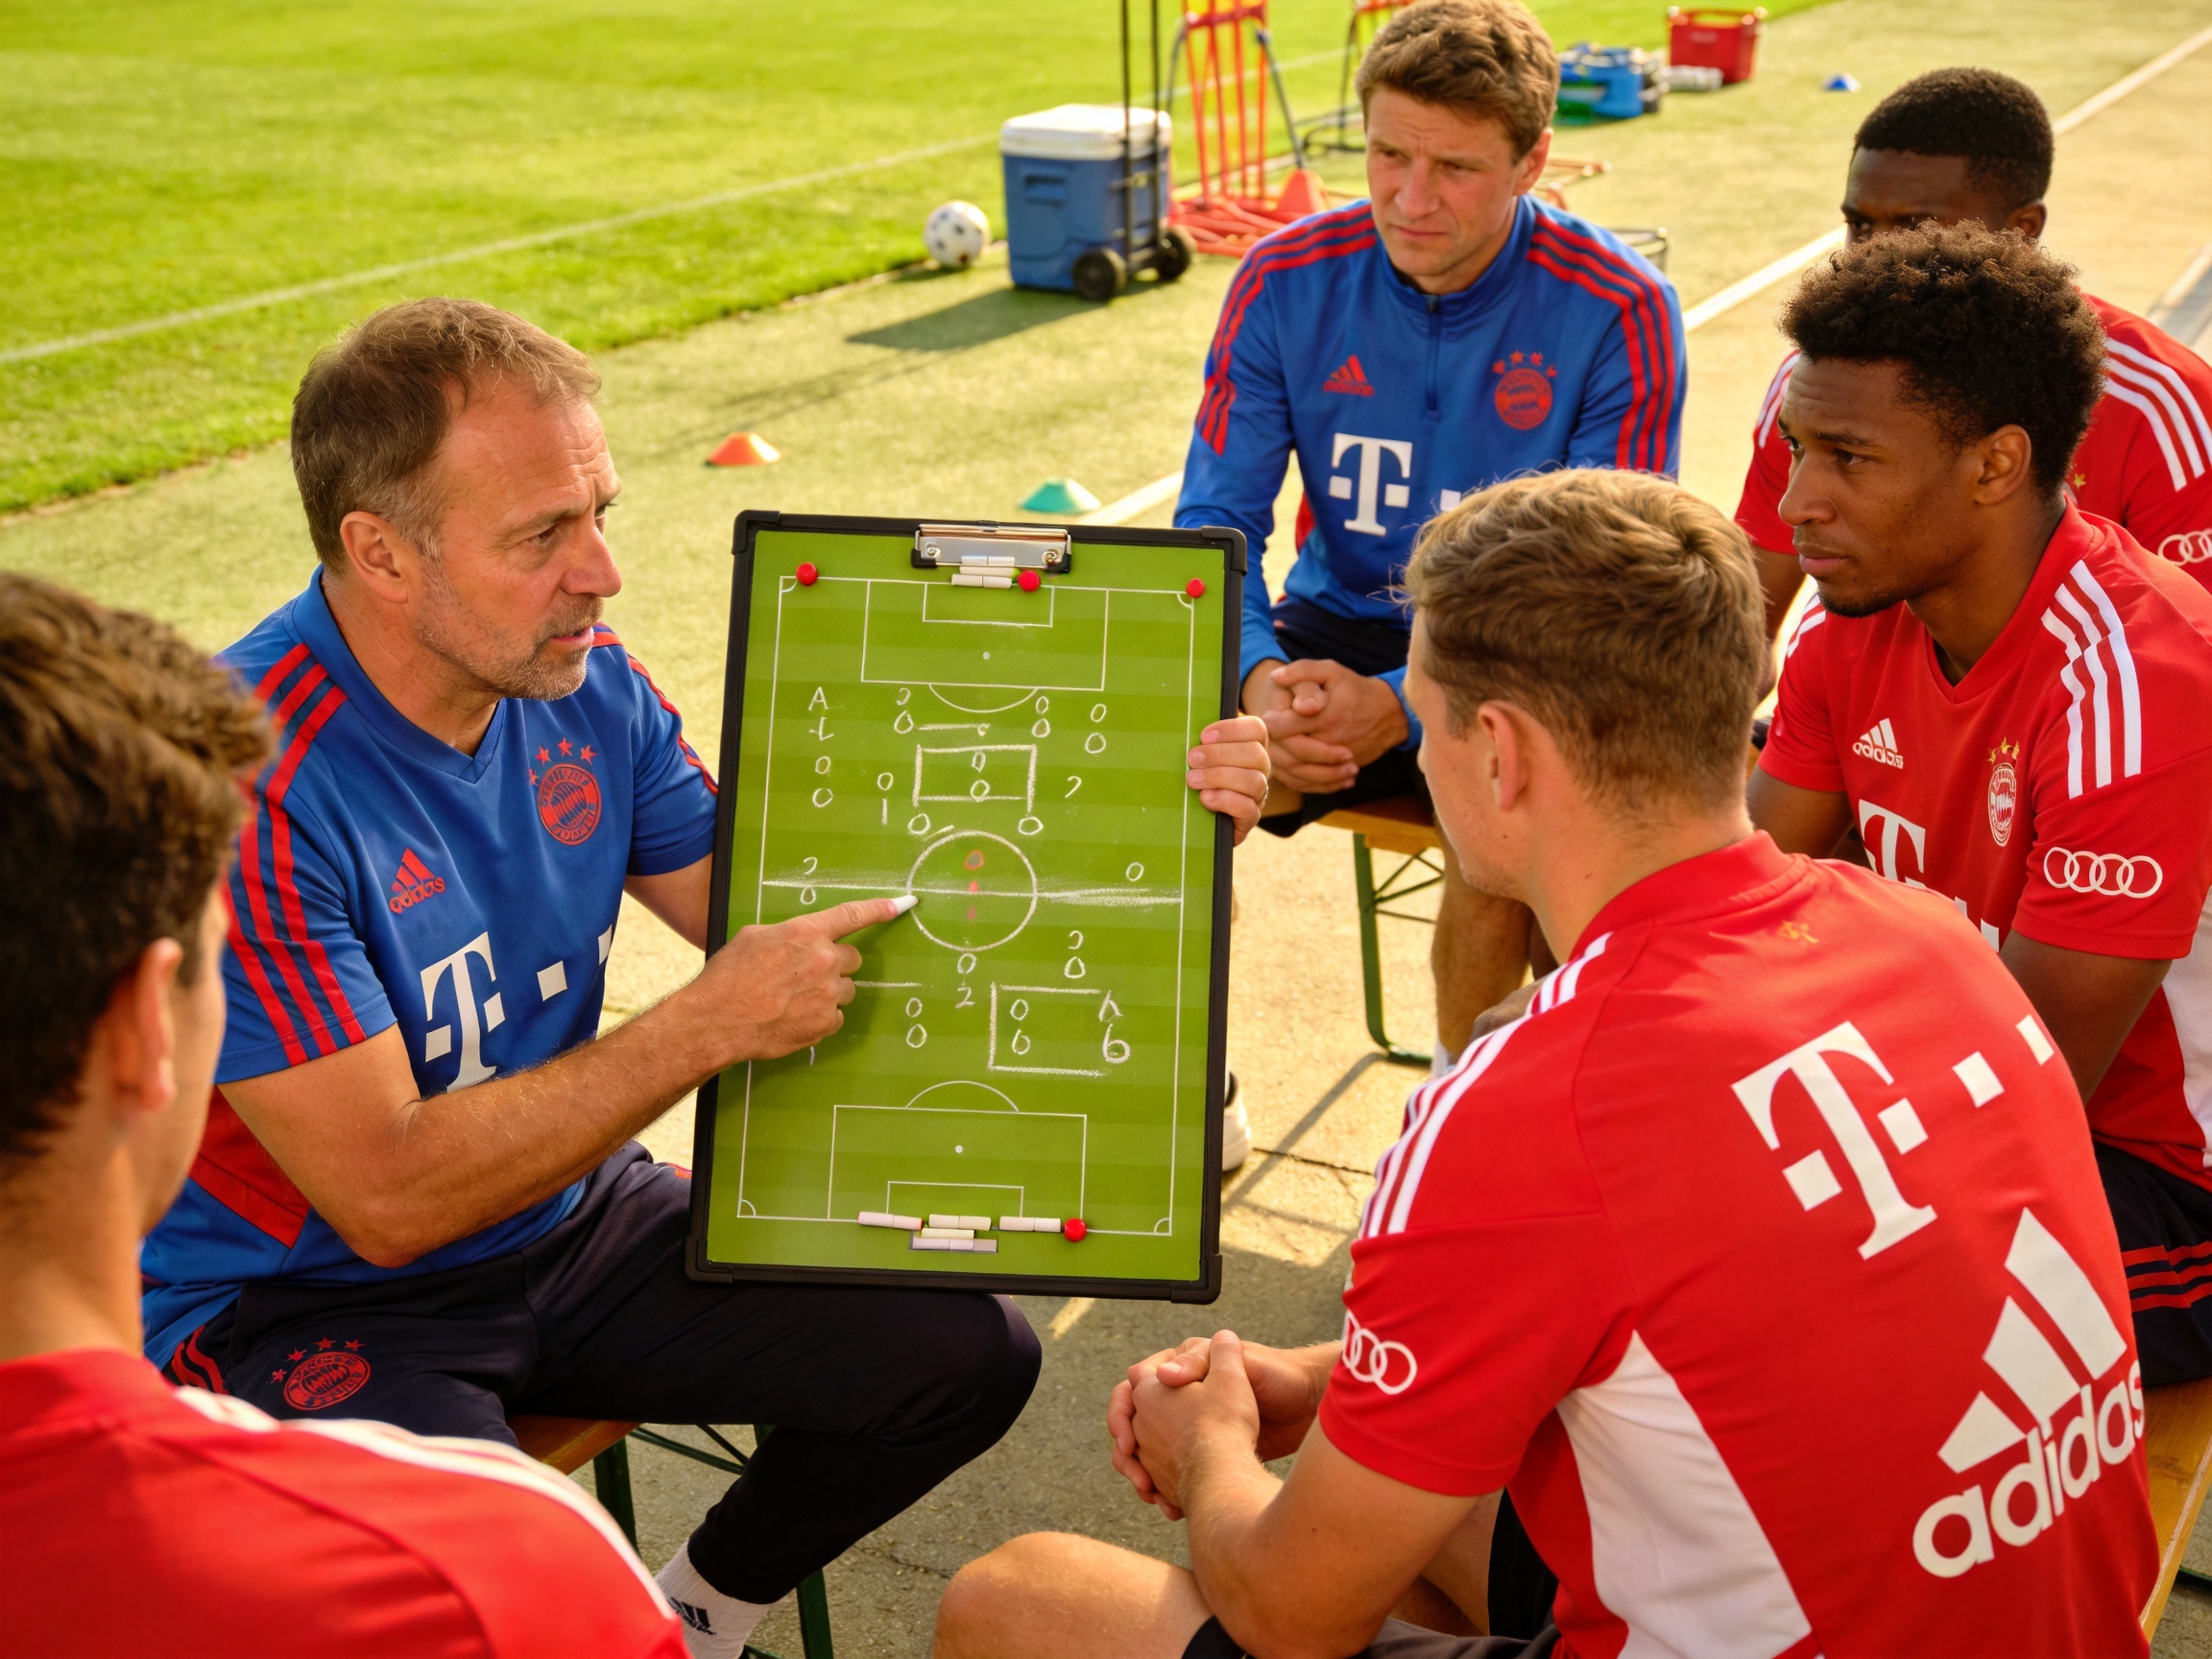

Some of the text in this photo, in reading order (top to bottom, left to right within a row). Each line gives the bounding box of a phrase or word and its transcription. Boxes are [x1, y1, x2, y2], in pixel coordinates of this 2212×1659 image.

[1329, 432, 1412, 537] T
[420, 931, 505, 1092] T
[1731, 1021, 1936, 1261] T
[1912, 1359, 2145, 1579] adidas
